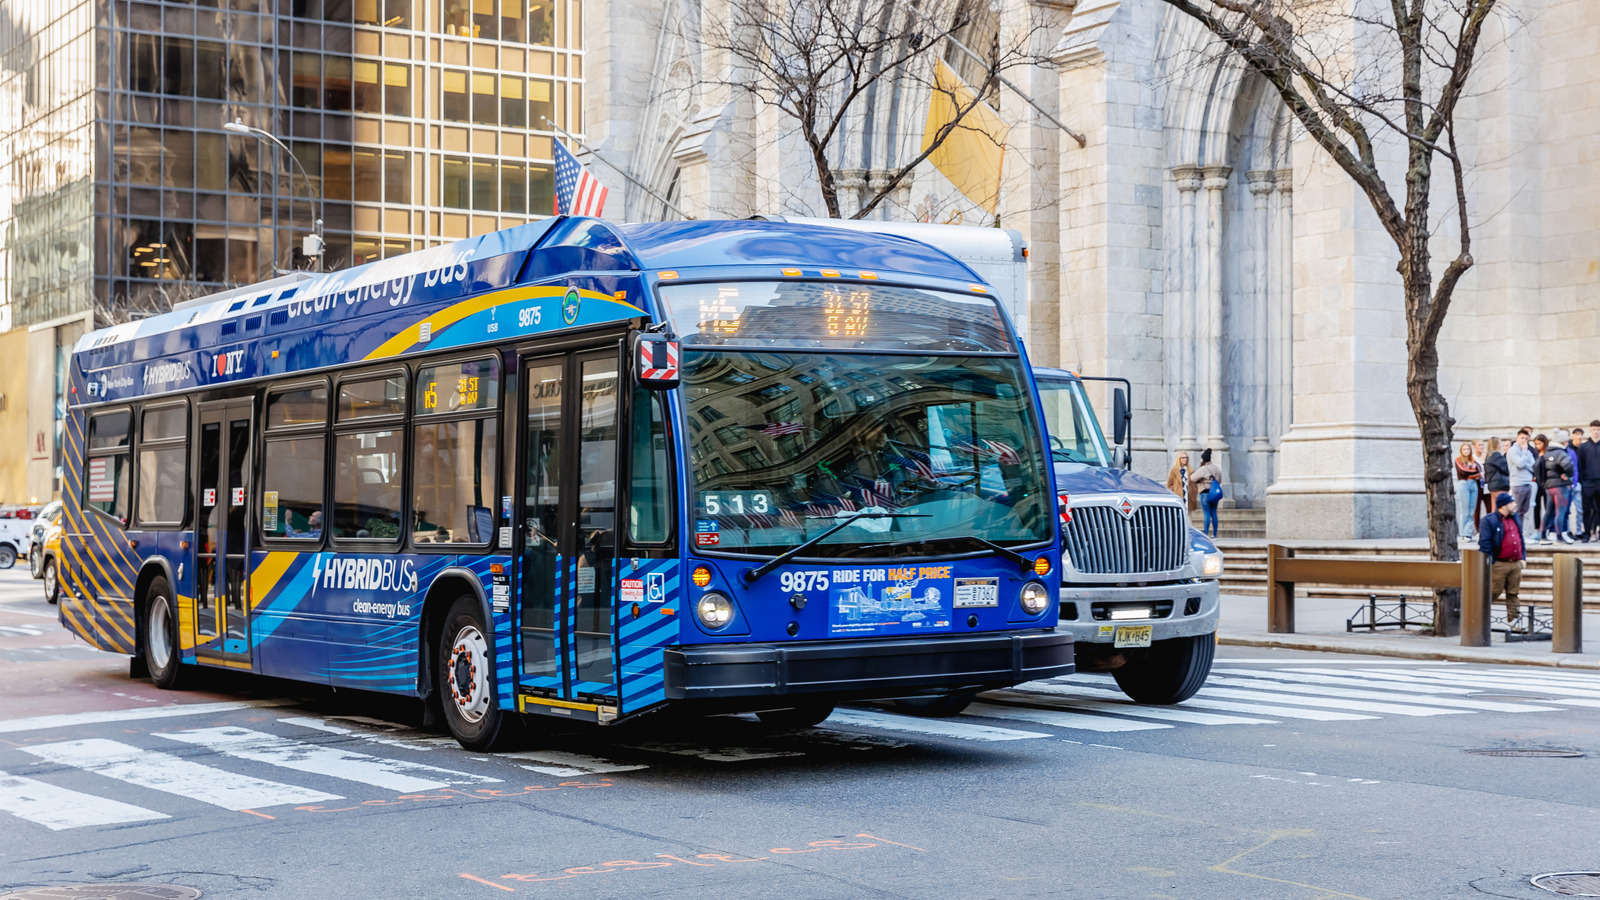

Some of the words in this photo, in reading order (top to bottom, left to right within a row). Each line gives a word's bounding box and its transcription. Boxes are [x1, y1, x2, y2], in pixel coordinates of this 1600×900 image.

[288, 265, 418, 318] clean-energy
[424, 249, 475, 288] bus
[518, 306, 541, 328] 9875
[699, 287, 741, 333] M5
[487, 323, 498, 333] USB
[148, 360, 191, 386] HYBRIDBUS
[468, 376, 479, 391] ST
[424, 382, 438, 409] M5
[467, 391, 478, 404] AV
[323, 558, 414, 592] HYBRIDBUS
[621, 580, 643, 588] CAUTION
[780, 571, 829, 593] 9875
[832, 569, 860, 583] RIDE
[863, 568, 885, 582] FOR
[888, 567, 916, 581] HALF
[919, 566, 951, 579] PRICE
[353, 599, 397, 618] clean-energy
[397, 600, 410, 616] bus
